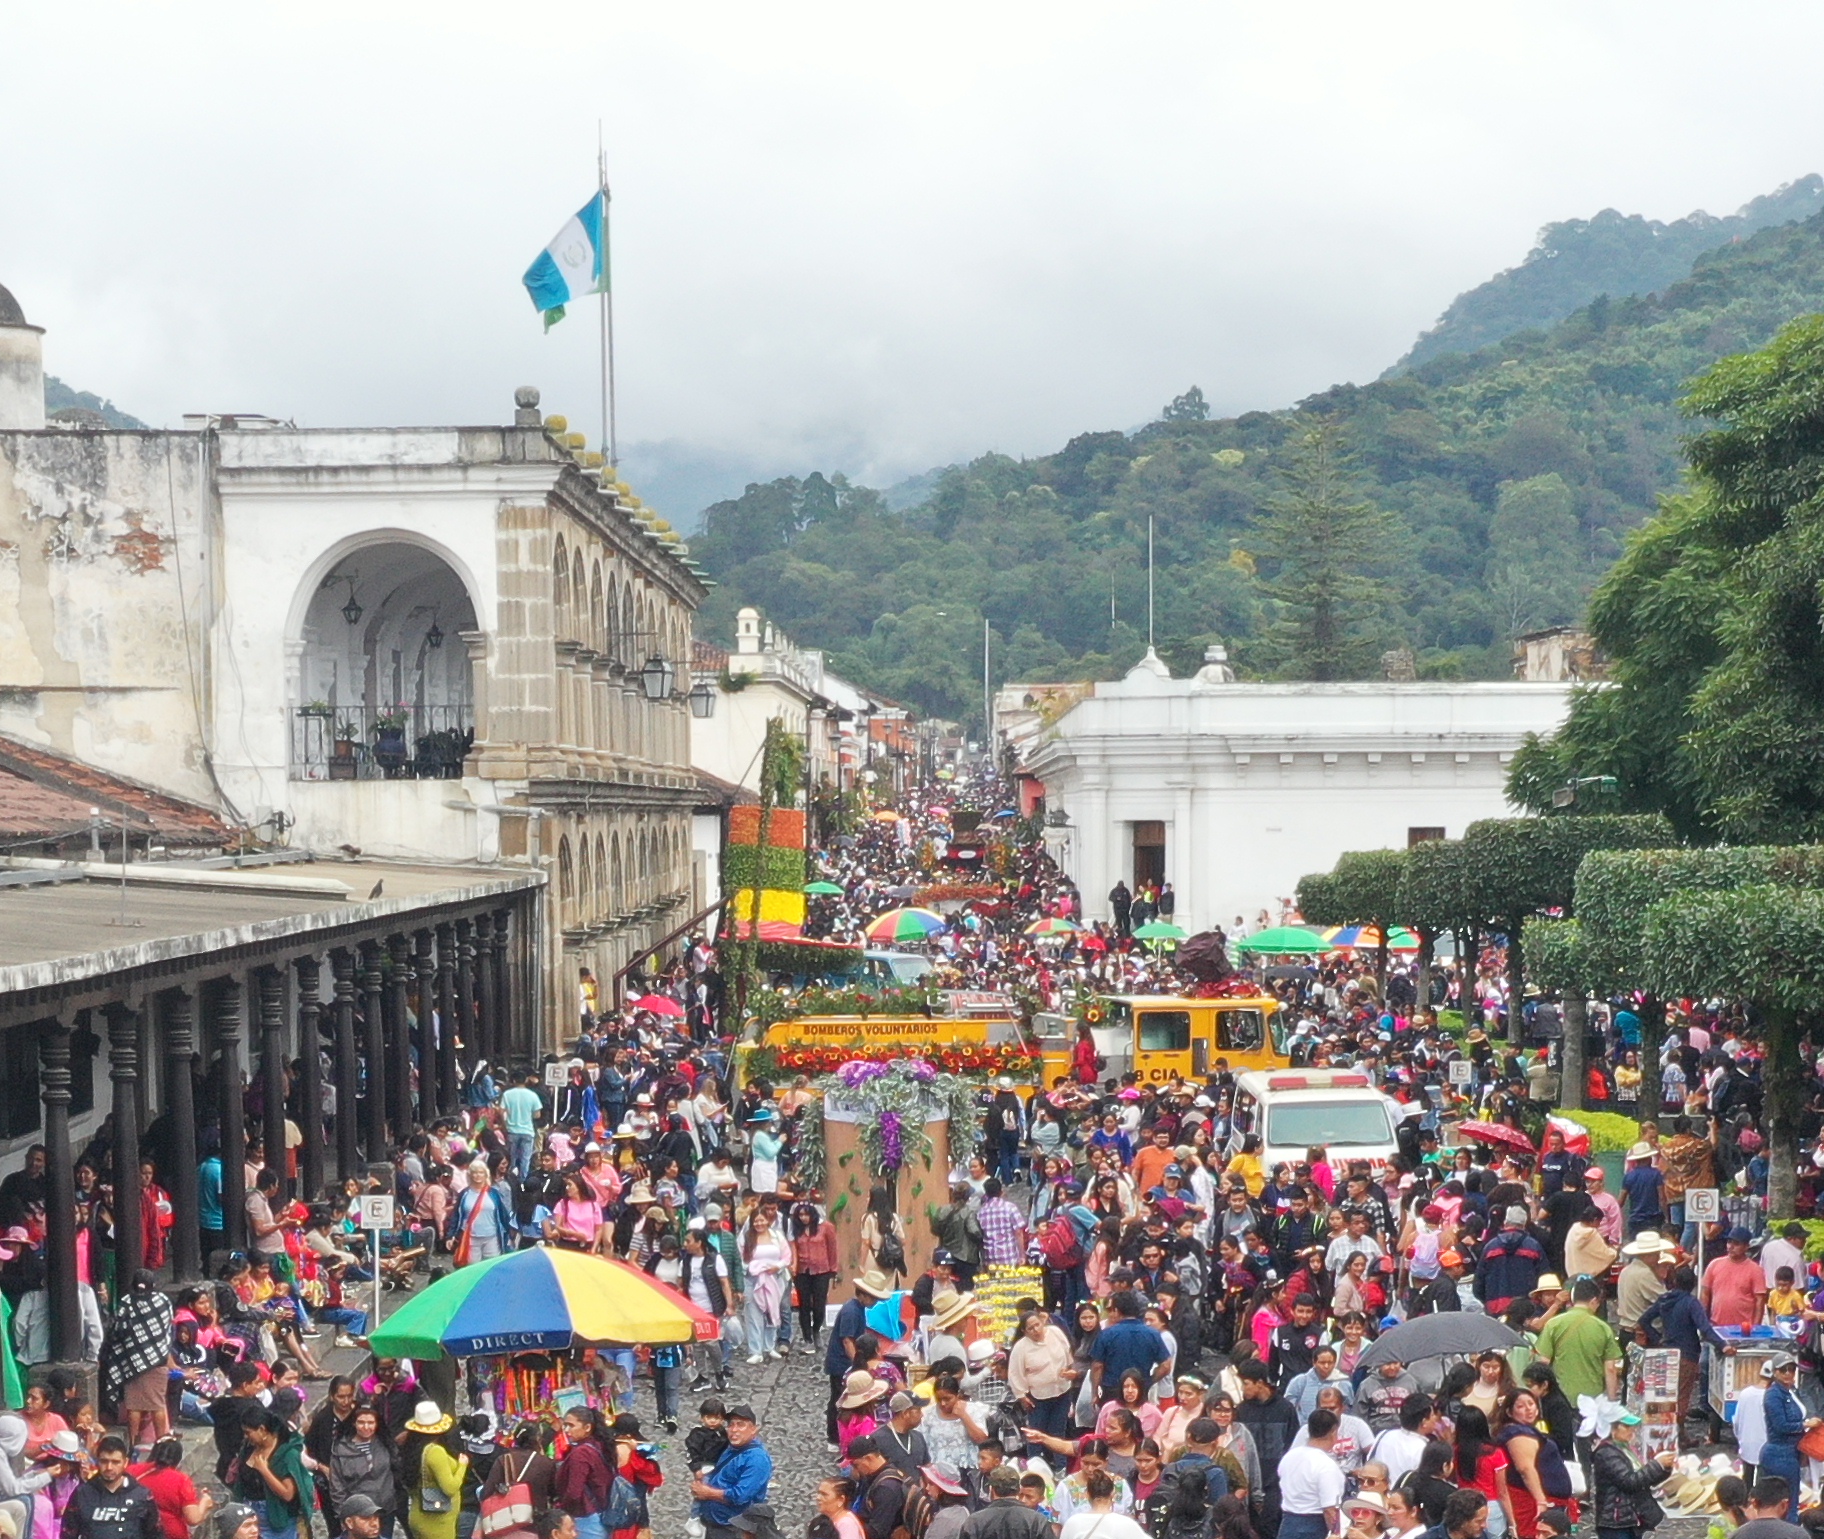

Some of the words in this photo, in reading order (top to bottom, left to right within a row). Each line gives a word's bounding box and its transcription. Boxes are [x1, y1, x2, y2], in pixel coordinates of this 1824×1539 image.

[803, 1025, 862, 1037] BOMBEROS
[865, 1025, 938, 1036] VOLUNTARIOS
[472, 1333, 545, 1350] DIRECT
